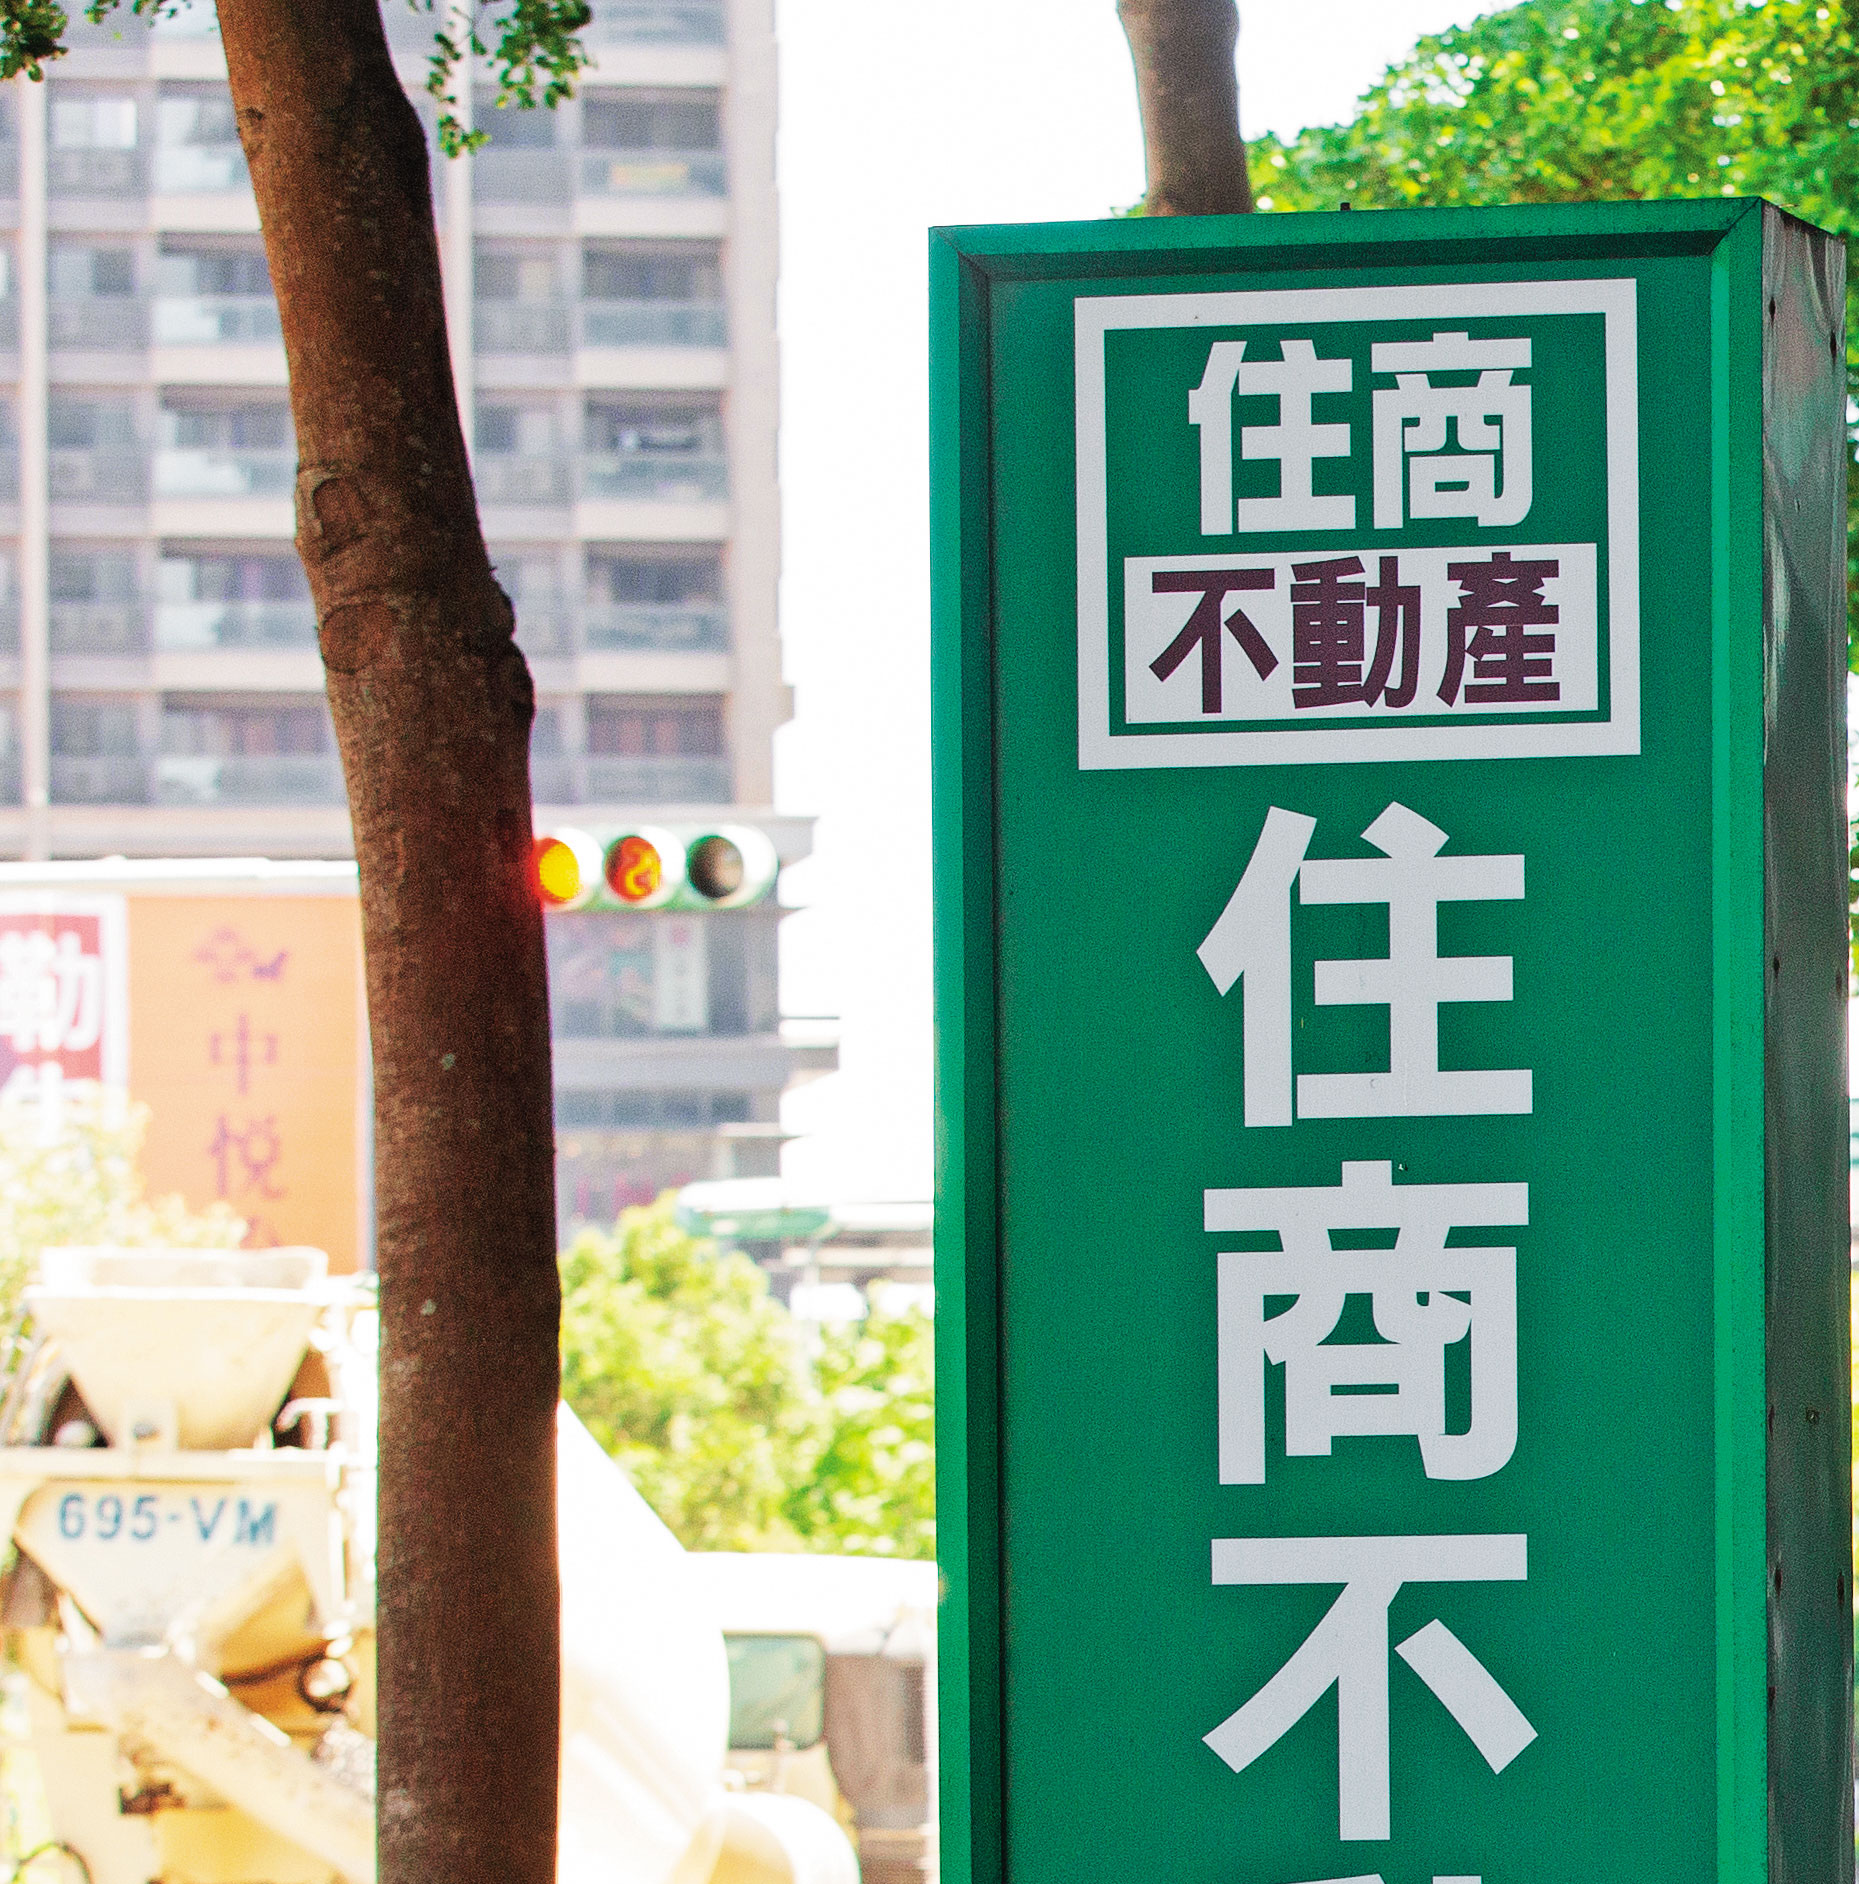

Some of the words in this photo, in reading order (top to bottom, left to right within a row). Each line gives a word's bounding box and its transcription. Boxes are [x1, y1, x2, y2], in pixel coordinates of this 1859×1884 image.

[1188, 331, 1533, 536] 住商
[1148, 551, 1561, 714] 不動產
